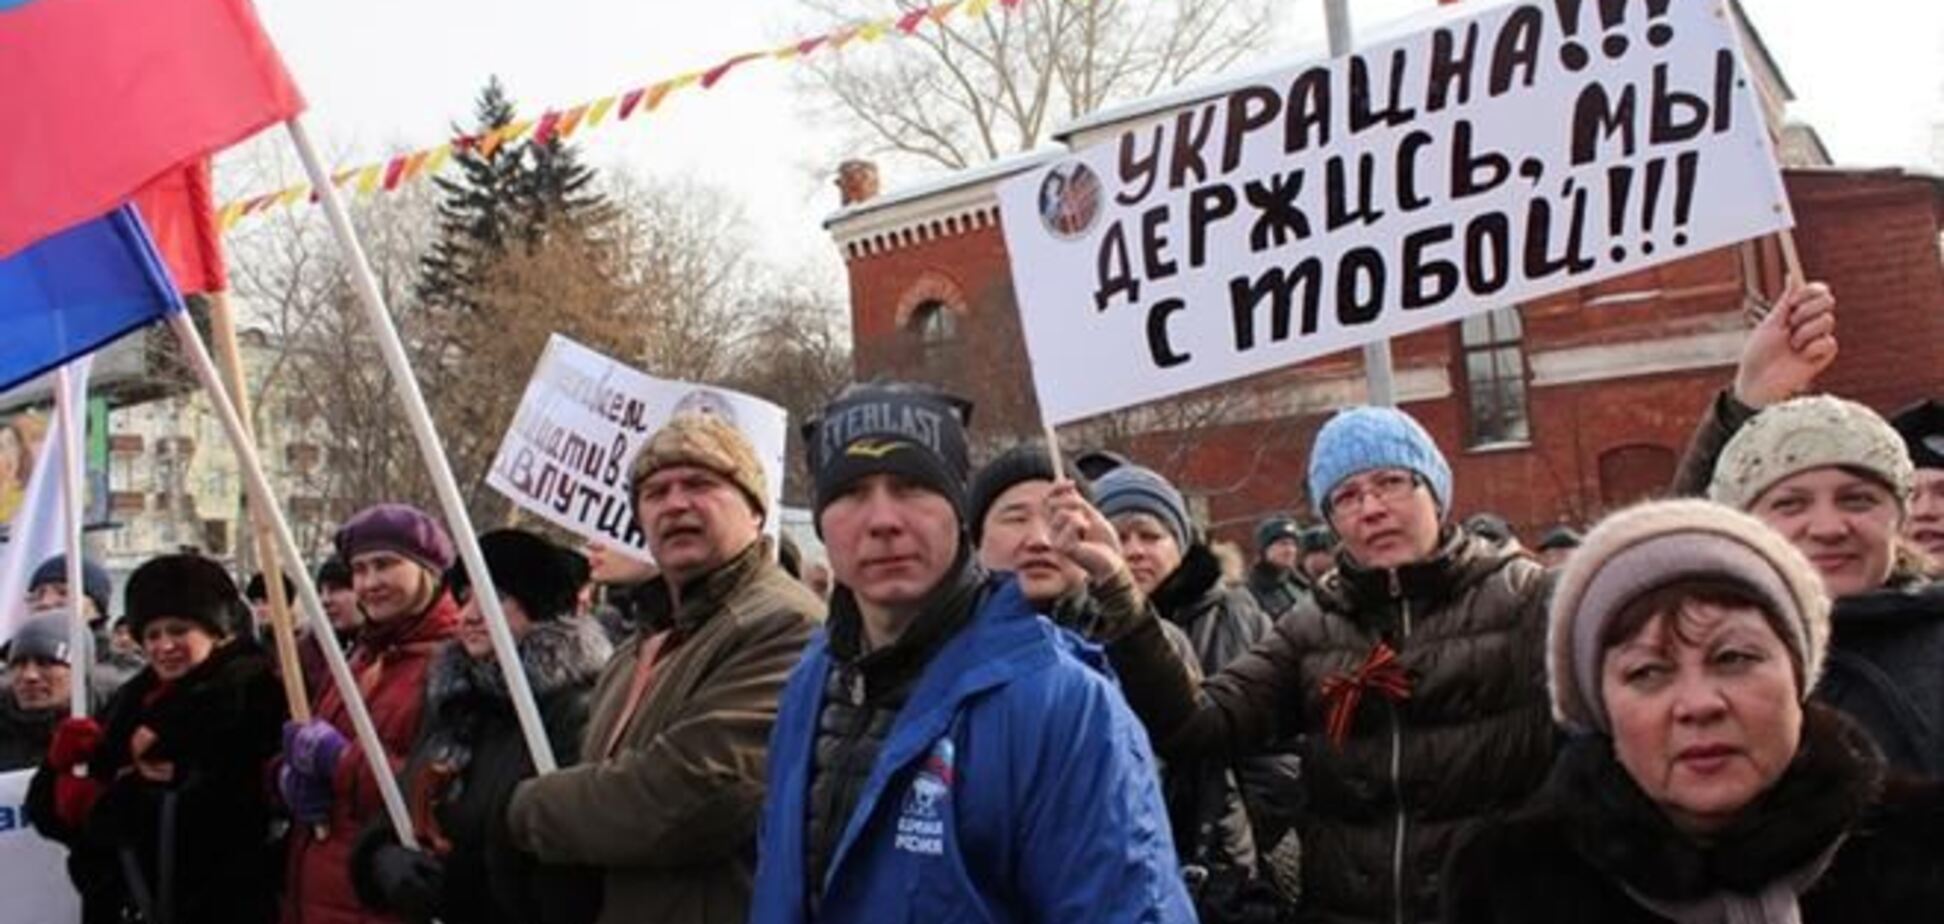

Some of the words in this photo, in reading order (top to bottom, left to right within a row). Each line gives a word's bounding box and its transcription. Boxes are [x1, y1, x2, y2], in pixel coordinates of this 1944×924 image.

[1095, 119, 1544, 311] ДЕРЖИСЬ,
[1571, 48, 1734, 166] МЫ
[821, 402, 943, 467] EVERLAST
